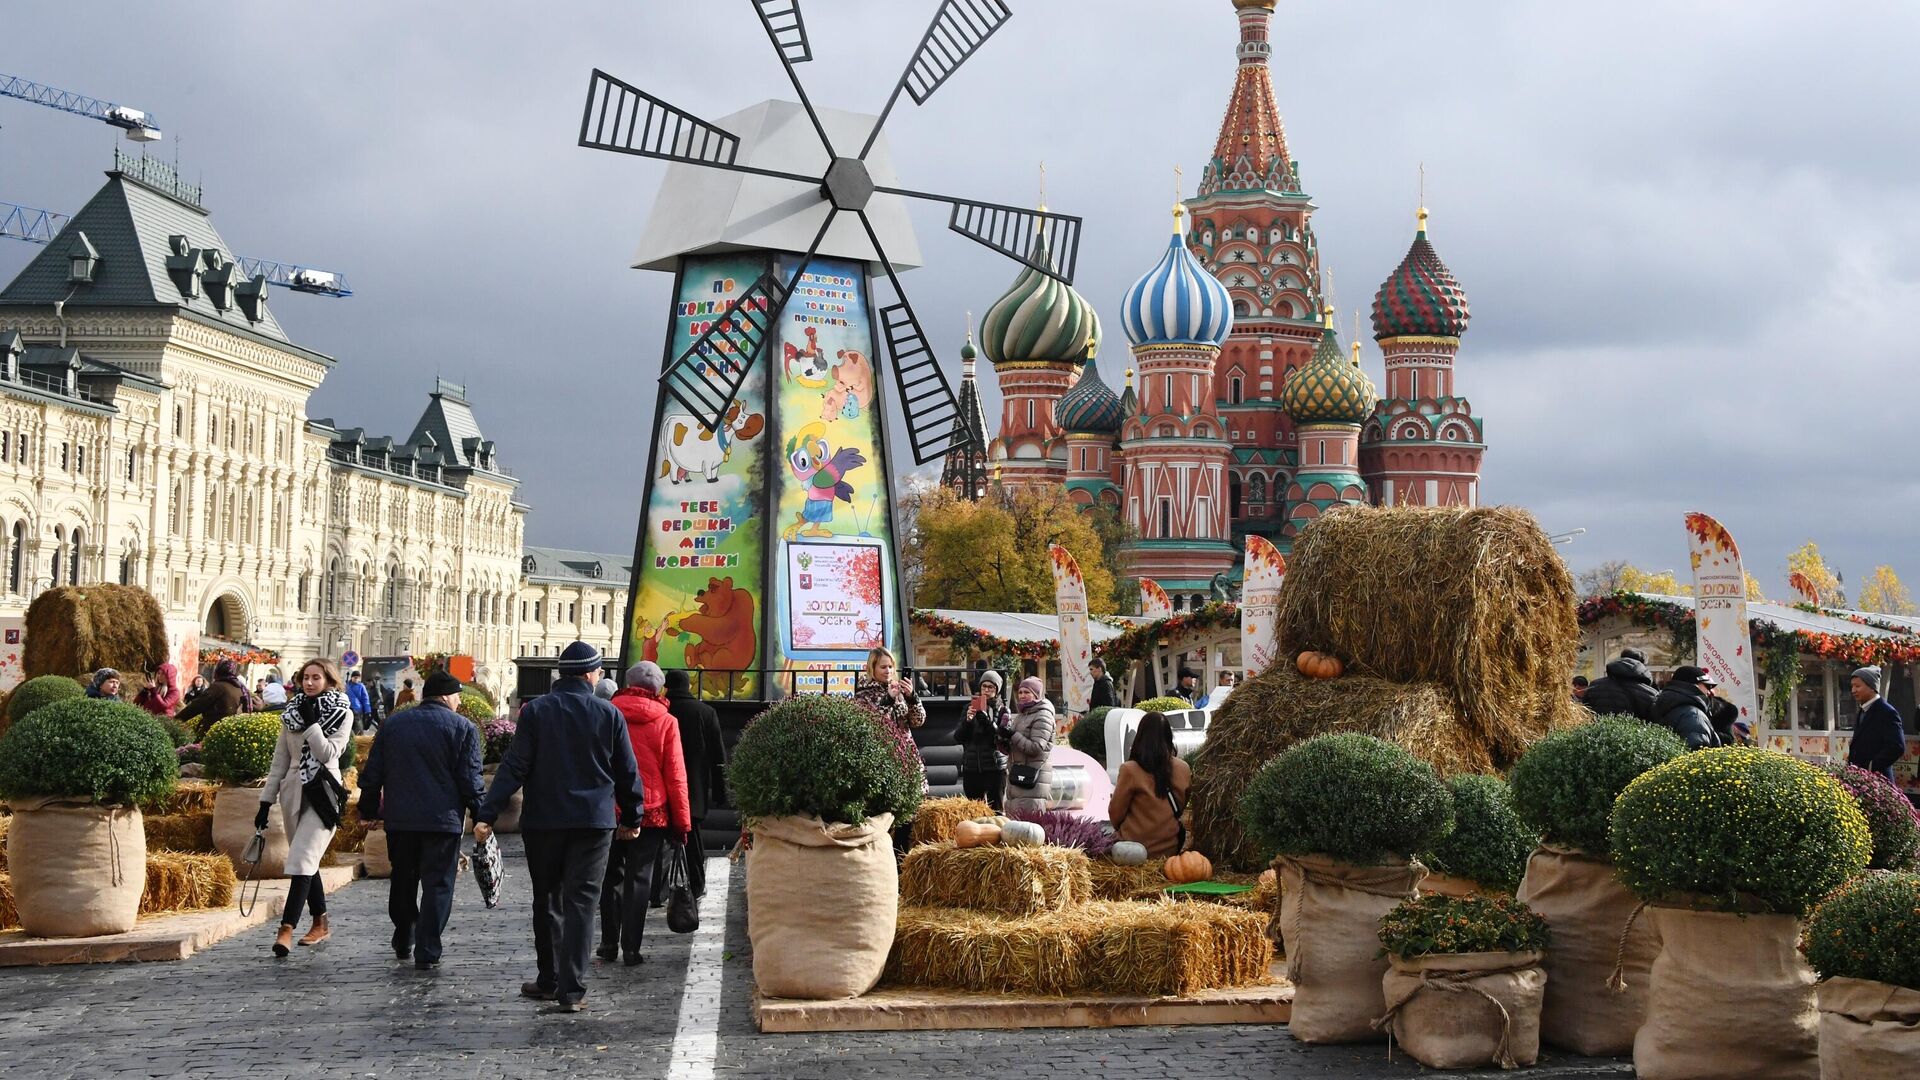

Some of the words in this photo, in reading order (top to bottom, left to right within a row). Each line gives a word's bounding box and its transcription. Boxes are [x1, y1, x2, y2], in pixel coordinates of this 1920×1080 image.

[713, 279, 735, 293] ПО
[815, 275, 852, 286] КОРОВА
[819, 303, 845, 313] КУРЫ
[680, 501, 718, 513] ТЕБЕ
[661, 517, 737, 533] ВЕРШКИ,
[655, 554, 739, 568] КОРЕШКИ
[1703, 652, 1726, 683] ОБЛАСТЬ
